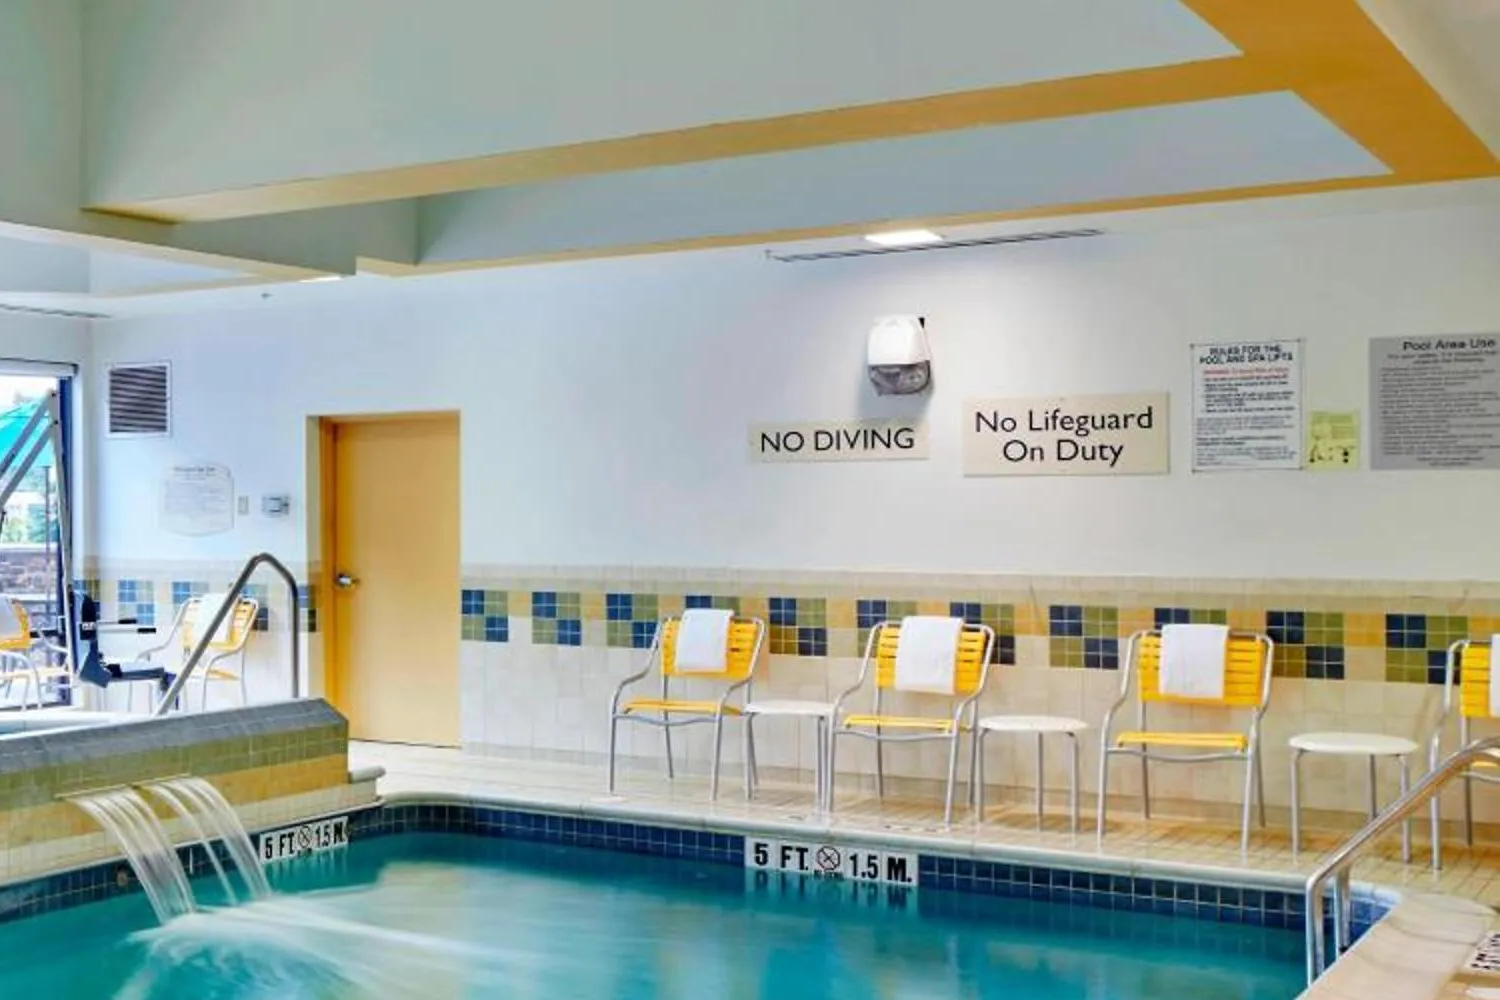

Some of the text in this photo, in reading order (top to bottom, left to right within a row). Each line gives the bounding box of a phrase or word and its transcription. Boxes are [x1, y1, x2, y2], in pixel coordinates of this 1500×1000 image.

[1402, 340, 1431, 351] Pool
[1435, 339, 1466, 350] Area
[975, 405, 1153, 437] No Lifeguard
[760, 427, 915, 453] NO DIVING
[1002, 439, 1125, 468] On Duty
[265, 836, 273, 859] 5
[754, 842, 768, 866] 5
[780, 845, 809, 871] FT.
[849, 853, 879, 879] 1.5
[887, 856, 913, 883] M.
